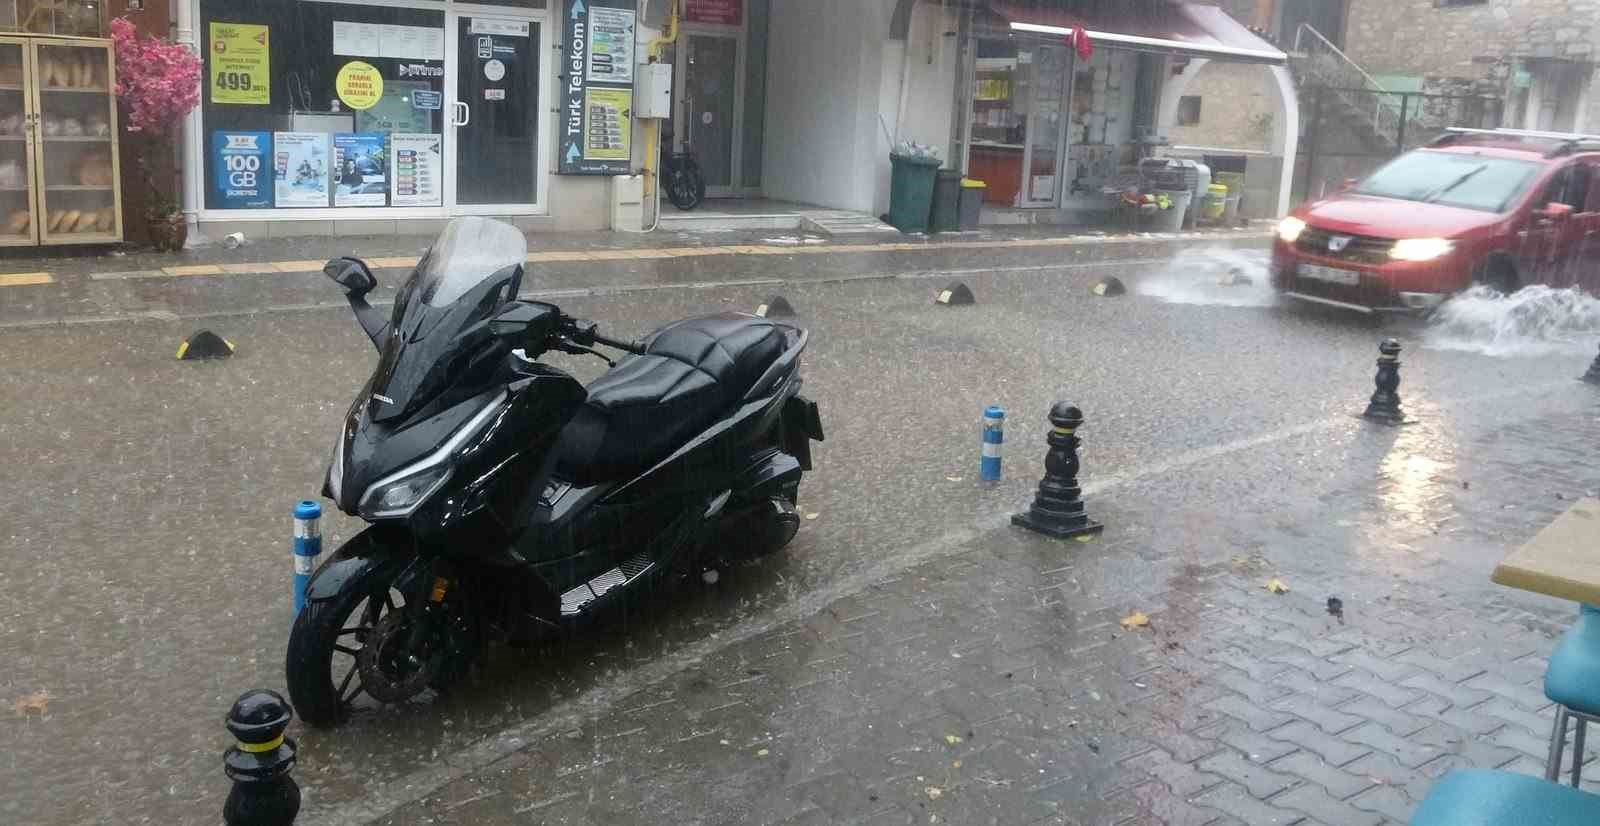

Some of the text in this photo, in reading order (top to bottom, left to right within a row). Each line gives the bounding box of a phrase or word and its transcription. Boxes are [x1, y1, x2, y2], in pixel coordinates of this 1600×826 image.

[216, 71, 251, 91] 499
[568, 22, 584, 136] Türk Telekom
[224, 155, 260, 171] 100
[230, 171, 257, 187] GB
